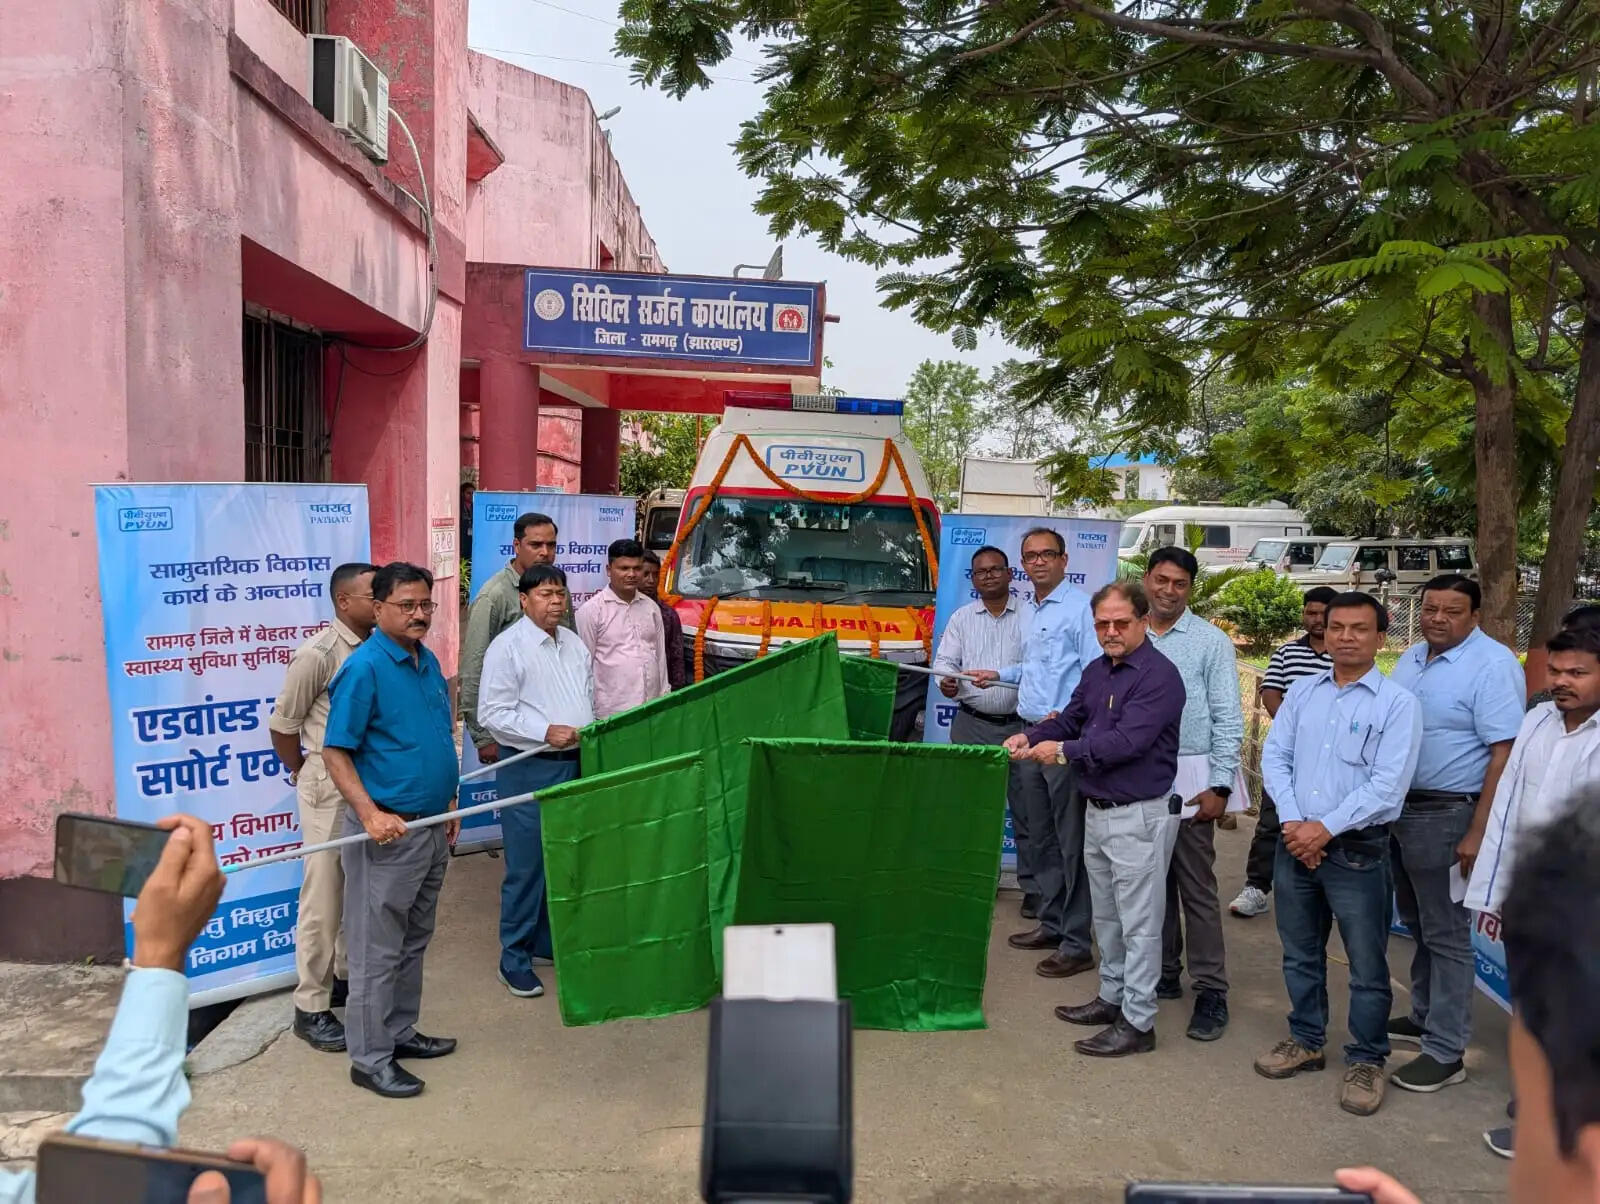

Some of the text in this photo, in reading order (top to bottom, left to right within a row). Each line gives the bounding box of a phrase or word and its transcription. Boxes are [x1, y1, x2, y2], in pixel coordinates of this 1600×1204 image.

[571, 283, 632, 324] सिविल
[637, 288, 686, 327] सर्जन
[690, 291, 769, 332] कार्यालय
[595, 328, 627, 346] जिला
[640, 333, 677, 352] रामगढ़
[683, 332, 743, 355] (झारखण्ड)
[784, 462, 847, 477] PVUN
[124, 520, 168, 530] PVUN
[569, 541, 608, 556] विकास
[149, 553, 331, 583] सामुदायिक विकास
[162, 578, 323, 606] कार्य के अन्तर्गत
[145, 632, 196, 652] रामगढ़
[200, 627, 234, 647] जिले
[239, 624, 253, 643] में
[255, 624, 297, 643] बेहतर
[125, 645, 296, 677] स्वास्थ्य सुविधा सुनिश्चि
[133, 694, 261, 742] एडवांस्ड
[136, 744, 231, 796] सपोर्ट
[230, 812, 300, 839] विभाग,
[230, 901, 291, 928] विद्युत
[189, 939, 258, 968] निगम
